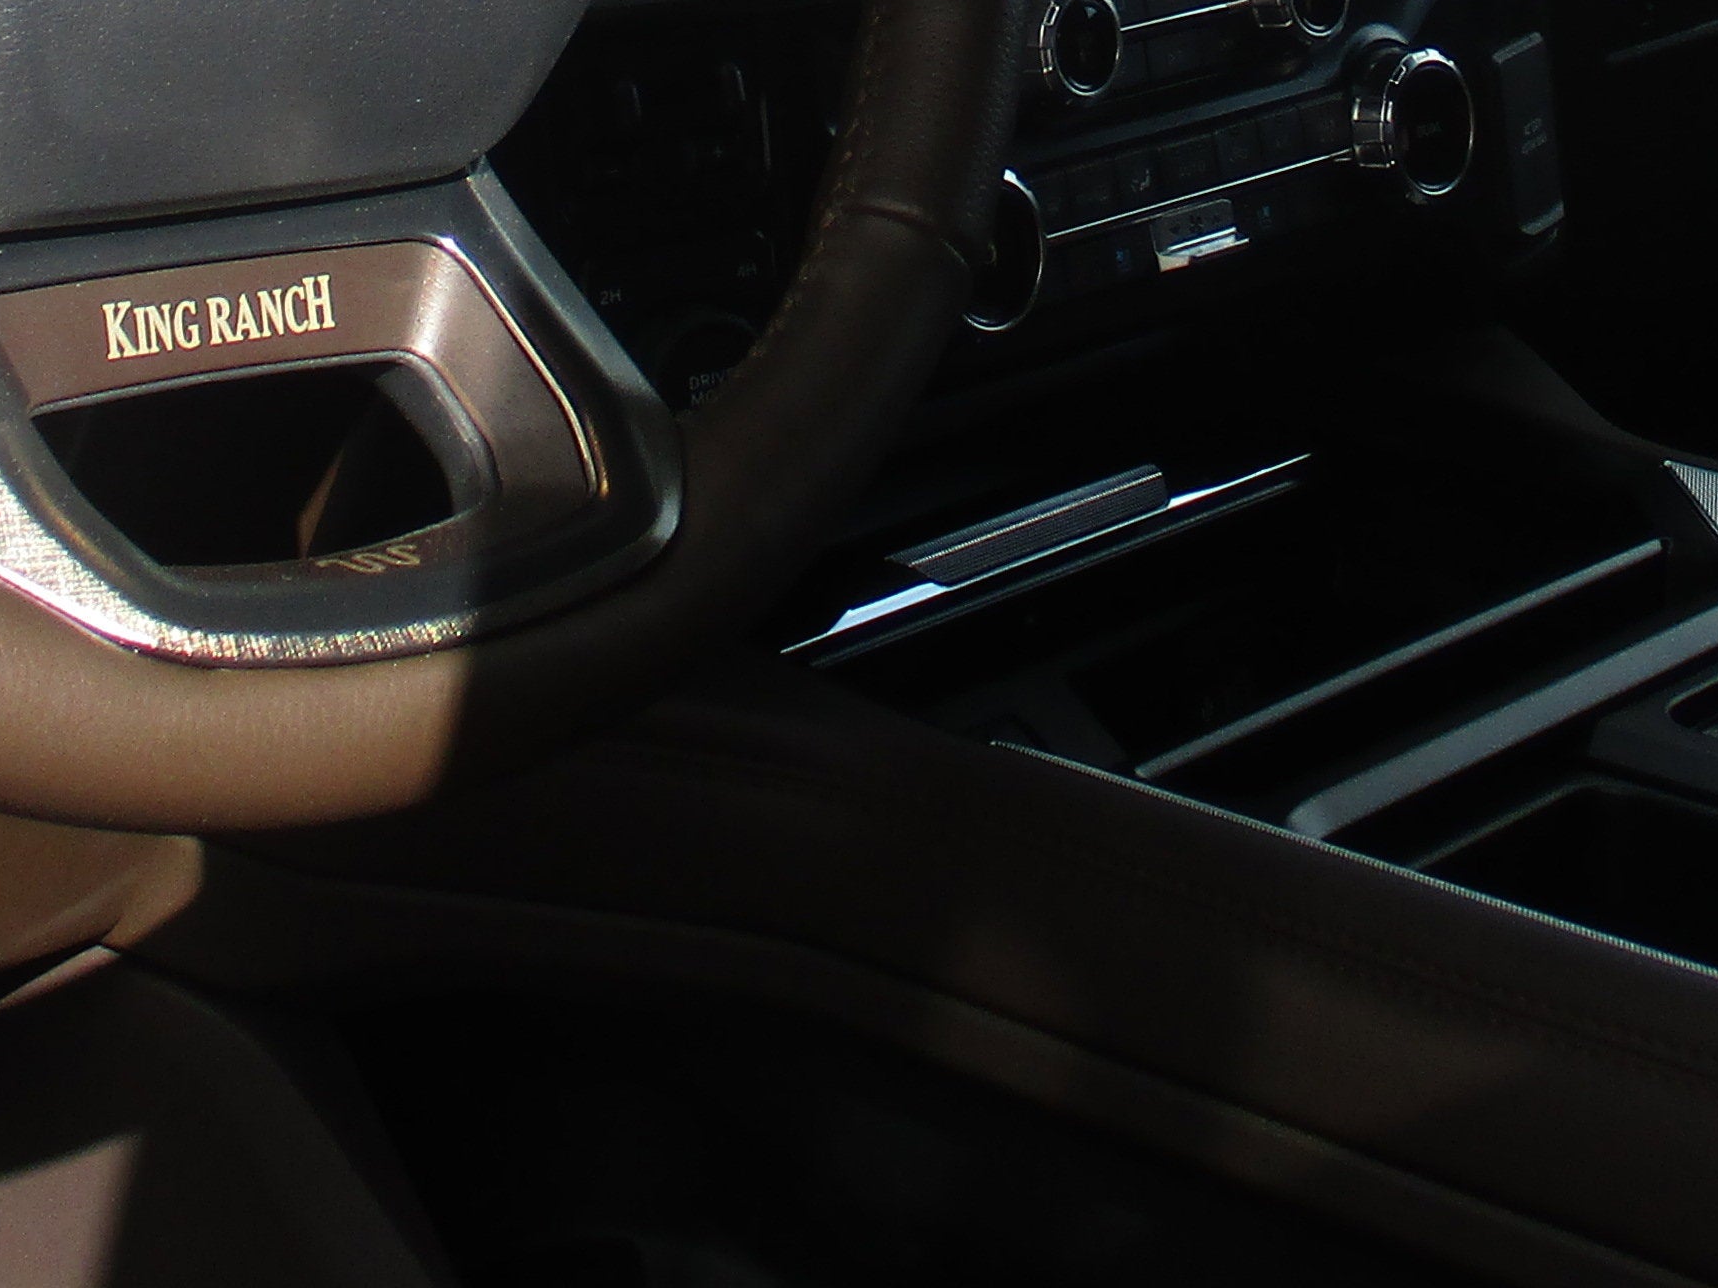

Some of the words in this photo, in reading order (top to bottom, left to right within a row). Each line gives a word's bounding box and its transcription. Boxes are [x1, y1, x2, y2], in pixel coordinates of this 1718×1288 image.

[599, 287, 623, 307] 2H
[101, 301, 201, 360] KING
[208, 274, 337, 345] RANCH
[687, 370, 731, 392] DRIV
